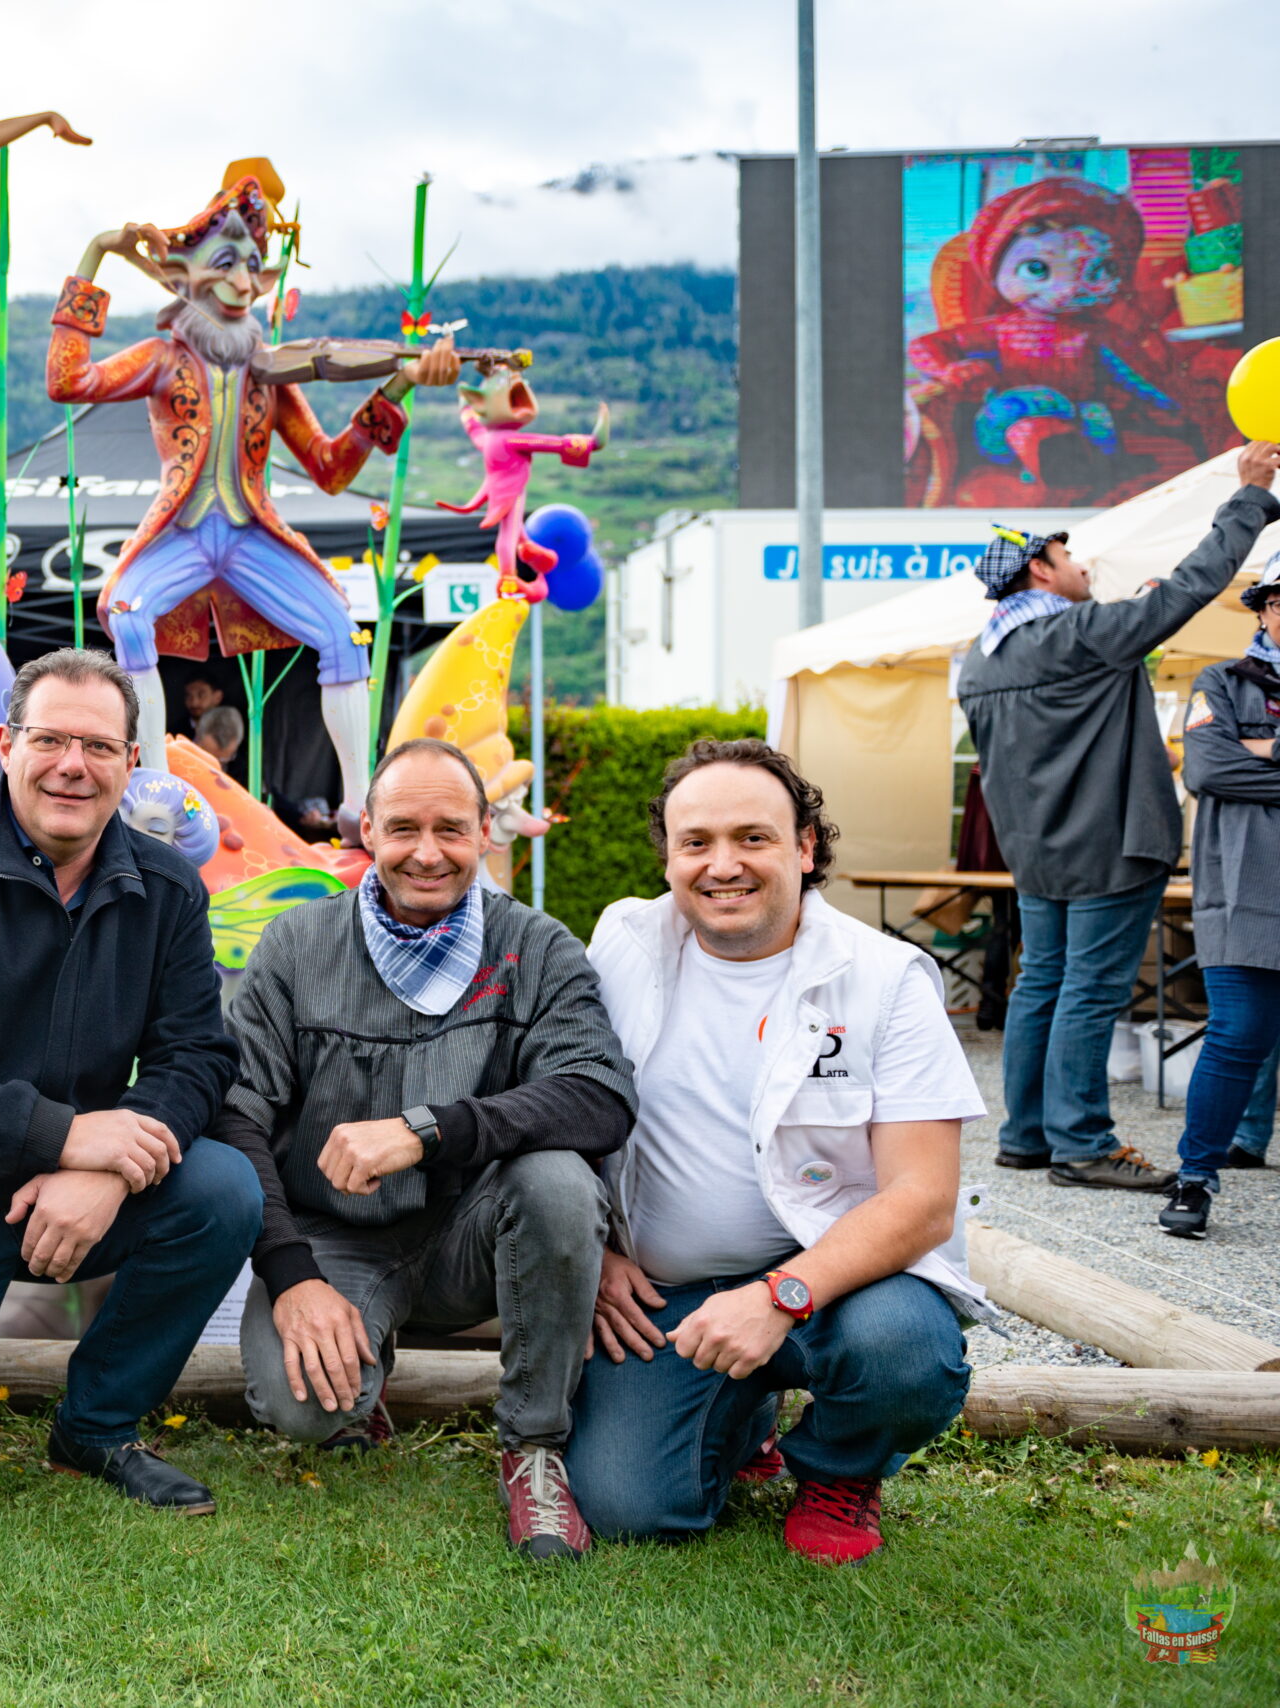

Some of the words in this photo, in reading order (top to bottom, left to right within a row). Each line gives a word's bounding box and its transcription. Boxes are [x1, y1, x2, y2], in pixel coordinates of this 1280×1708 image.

[777, 549, 799, 578] J
[830, 548, 893, 578] suis
[904, 545, 929, 578] à
